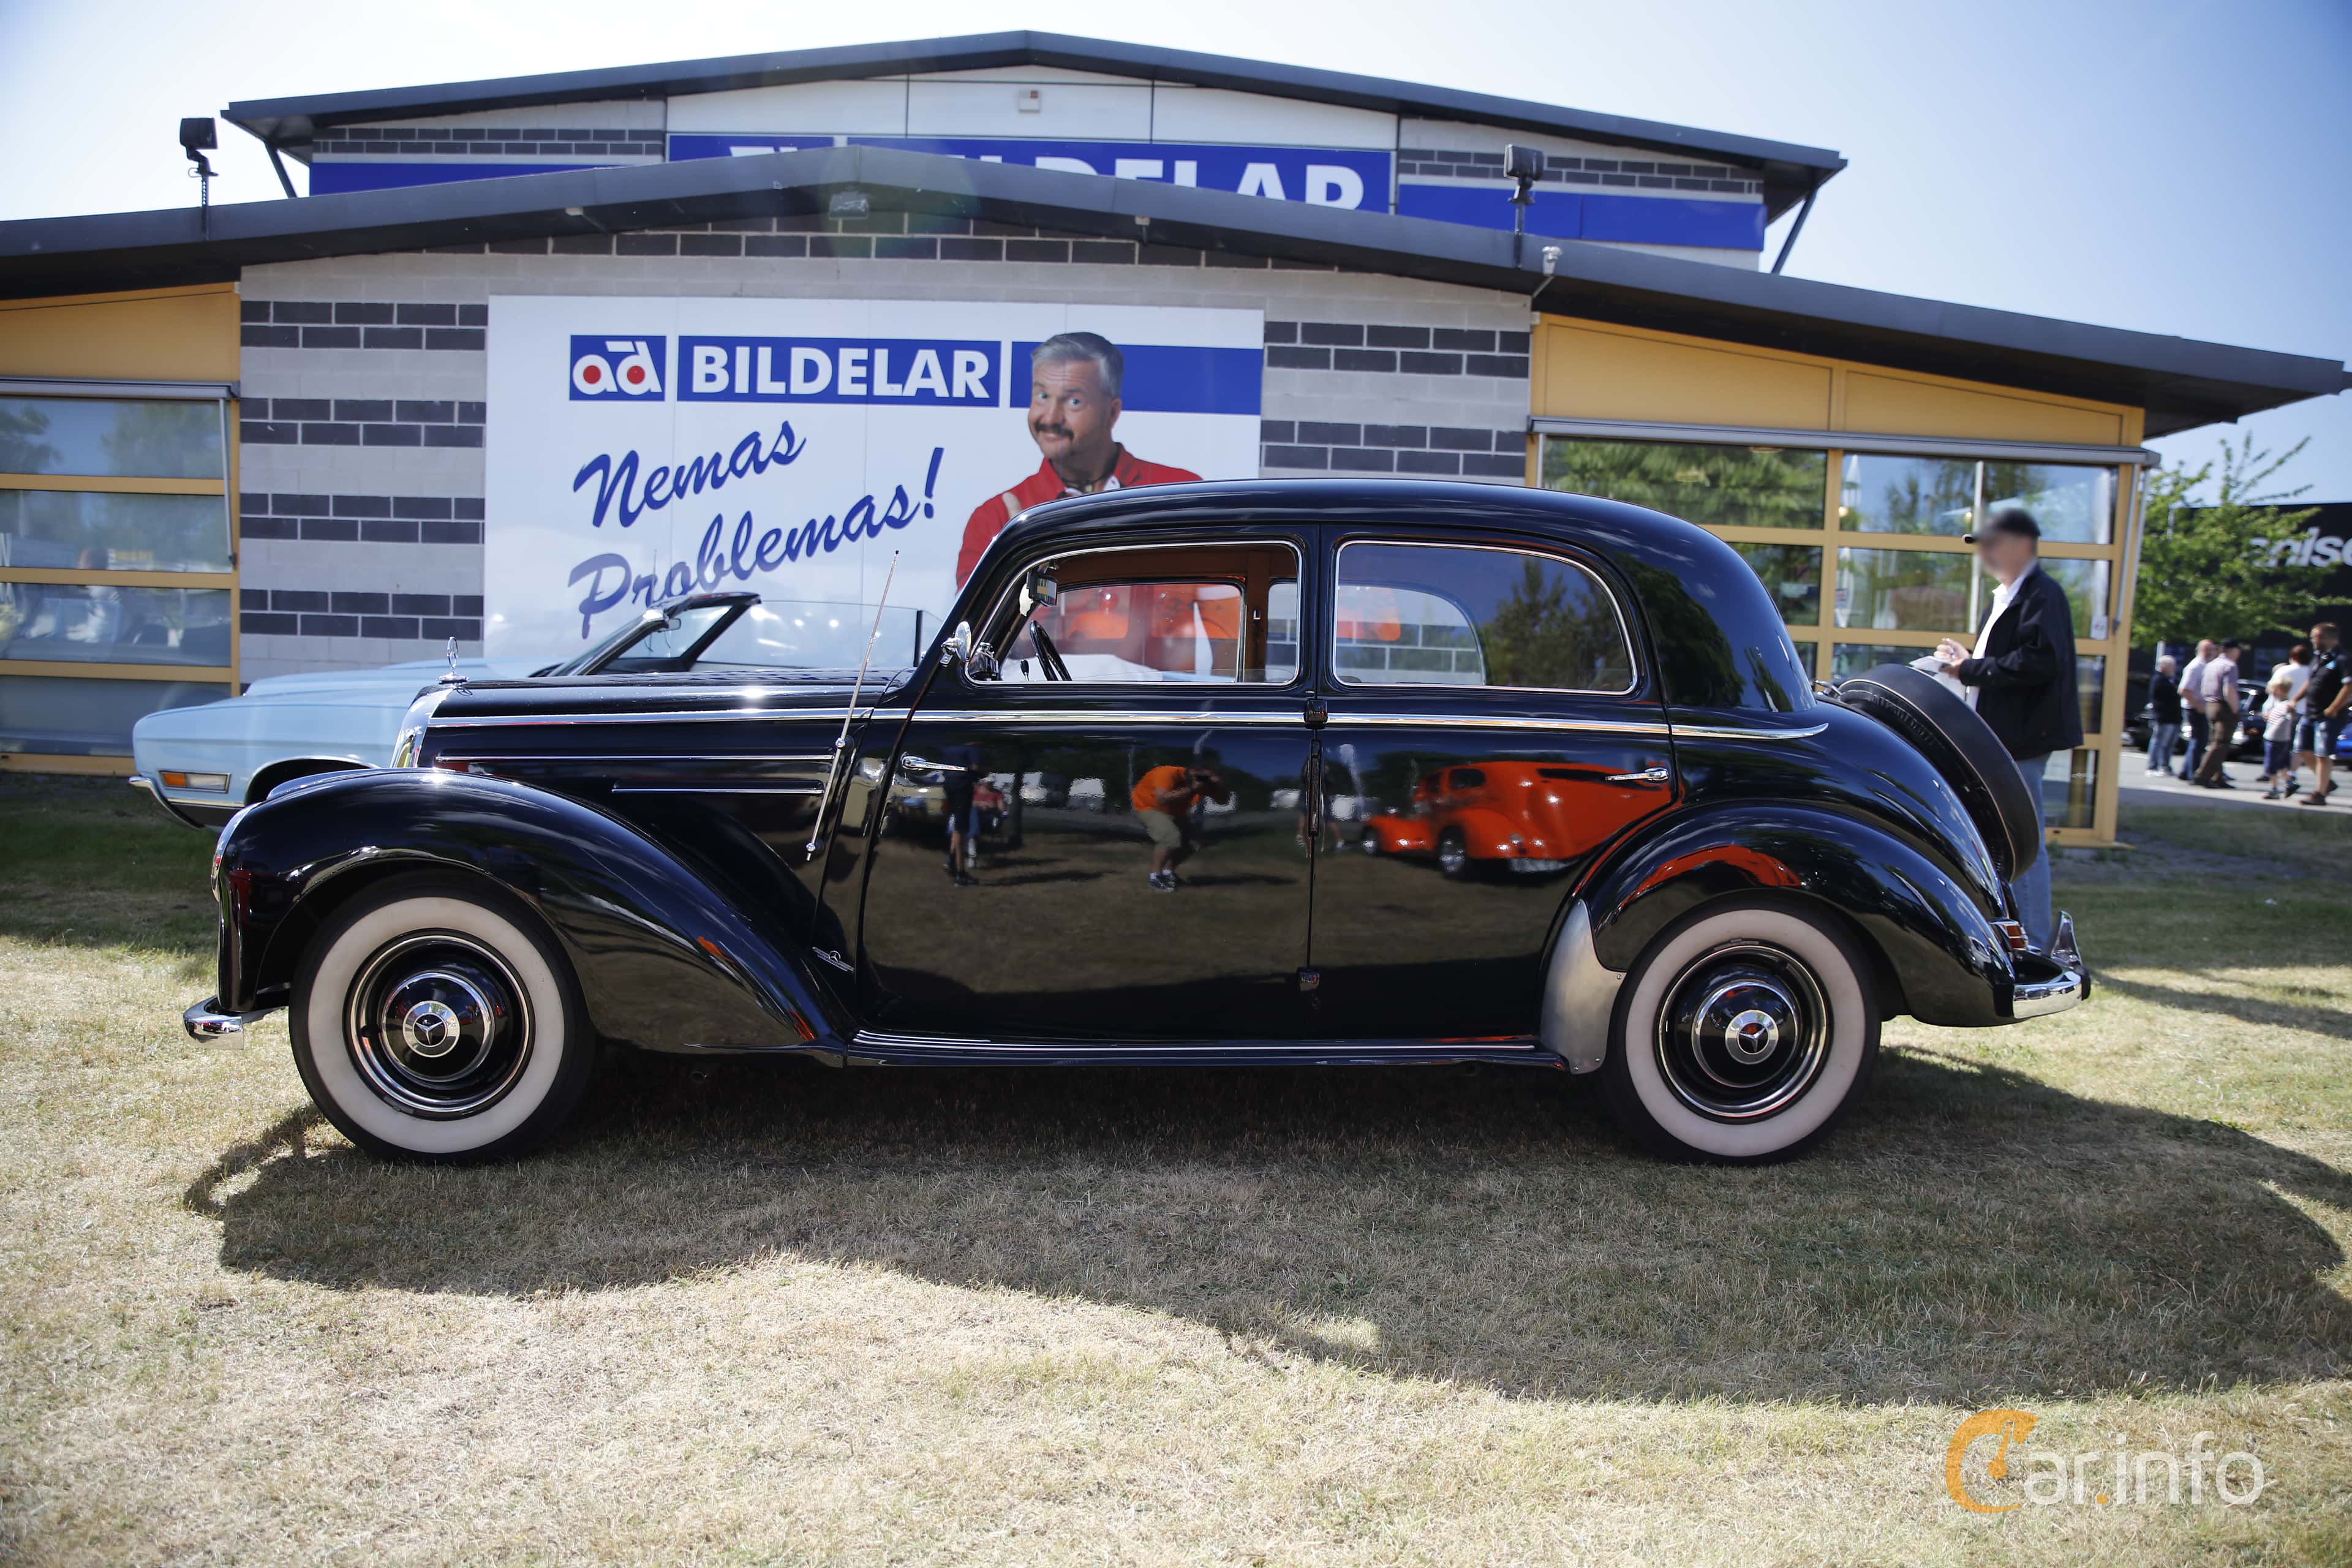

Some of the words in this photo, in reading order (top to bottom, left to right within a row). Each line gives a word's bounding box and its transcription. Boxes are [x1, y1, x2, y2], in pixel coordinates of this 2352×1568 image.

[692, 345, 990, 399] BILDELAR
[573, 420, 807, 529] Nemas
[568, 447, 945, 639] Problemas!
